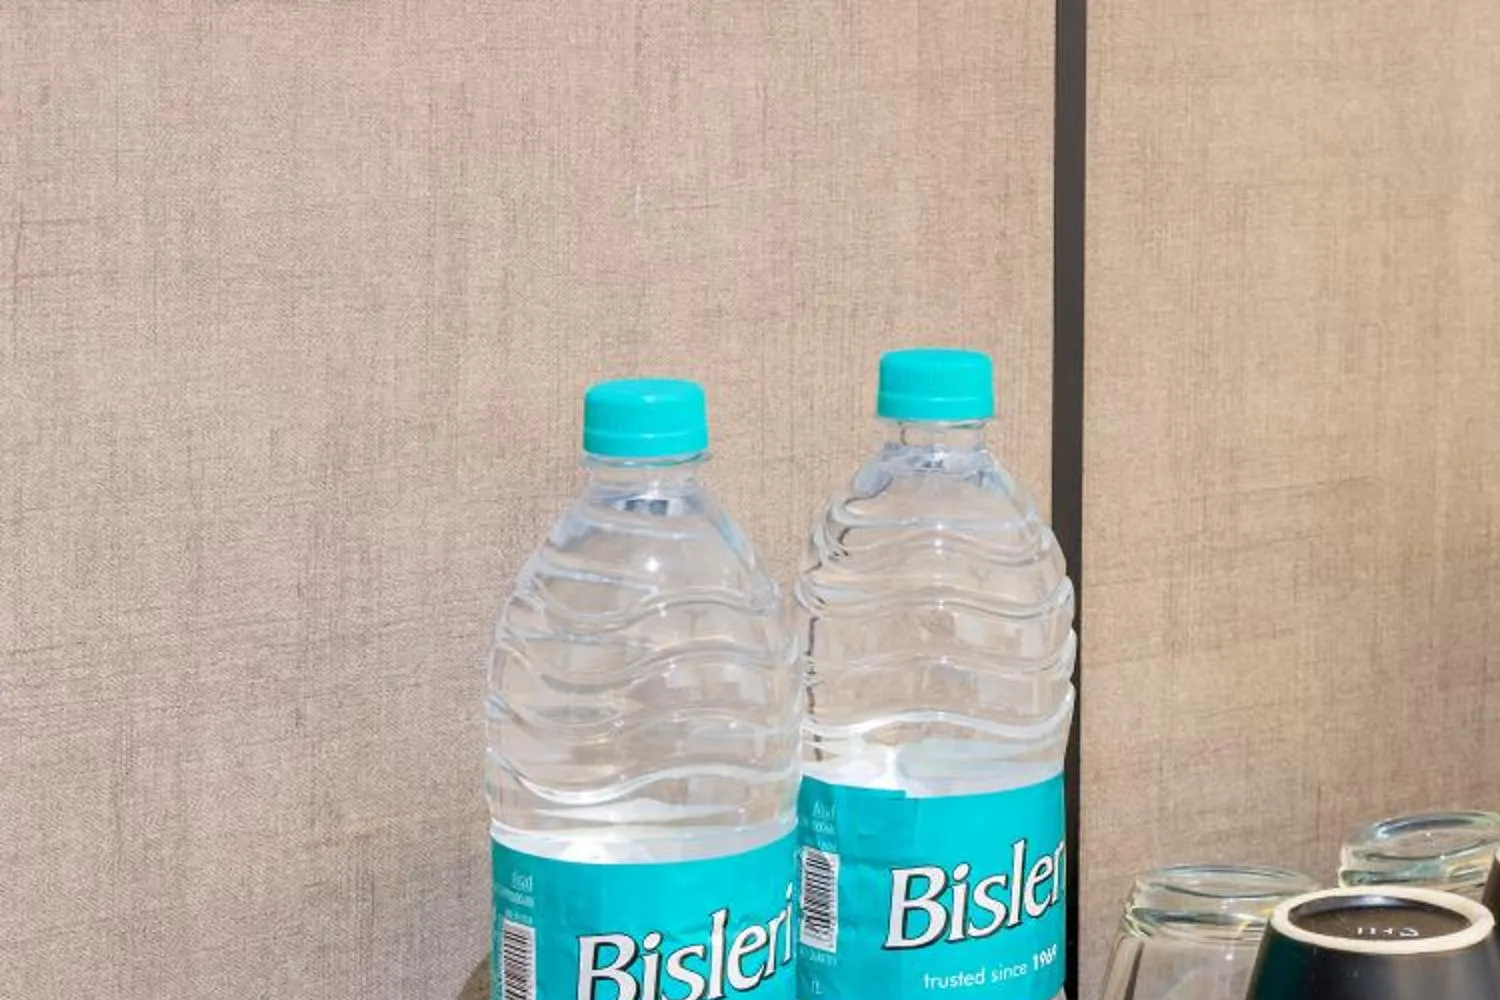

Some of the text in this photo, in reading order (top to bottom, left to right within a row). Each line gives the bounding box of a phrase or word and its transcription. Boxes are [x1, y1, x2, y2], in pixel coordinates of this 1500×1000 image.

[882, 837, 1066, 950] Bisler
[923, 967, 986, 989] trusted
[991, 962, 1028, 984] since
